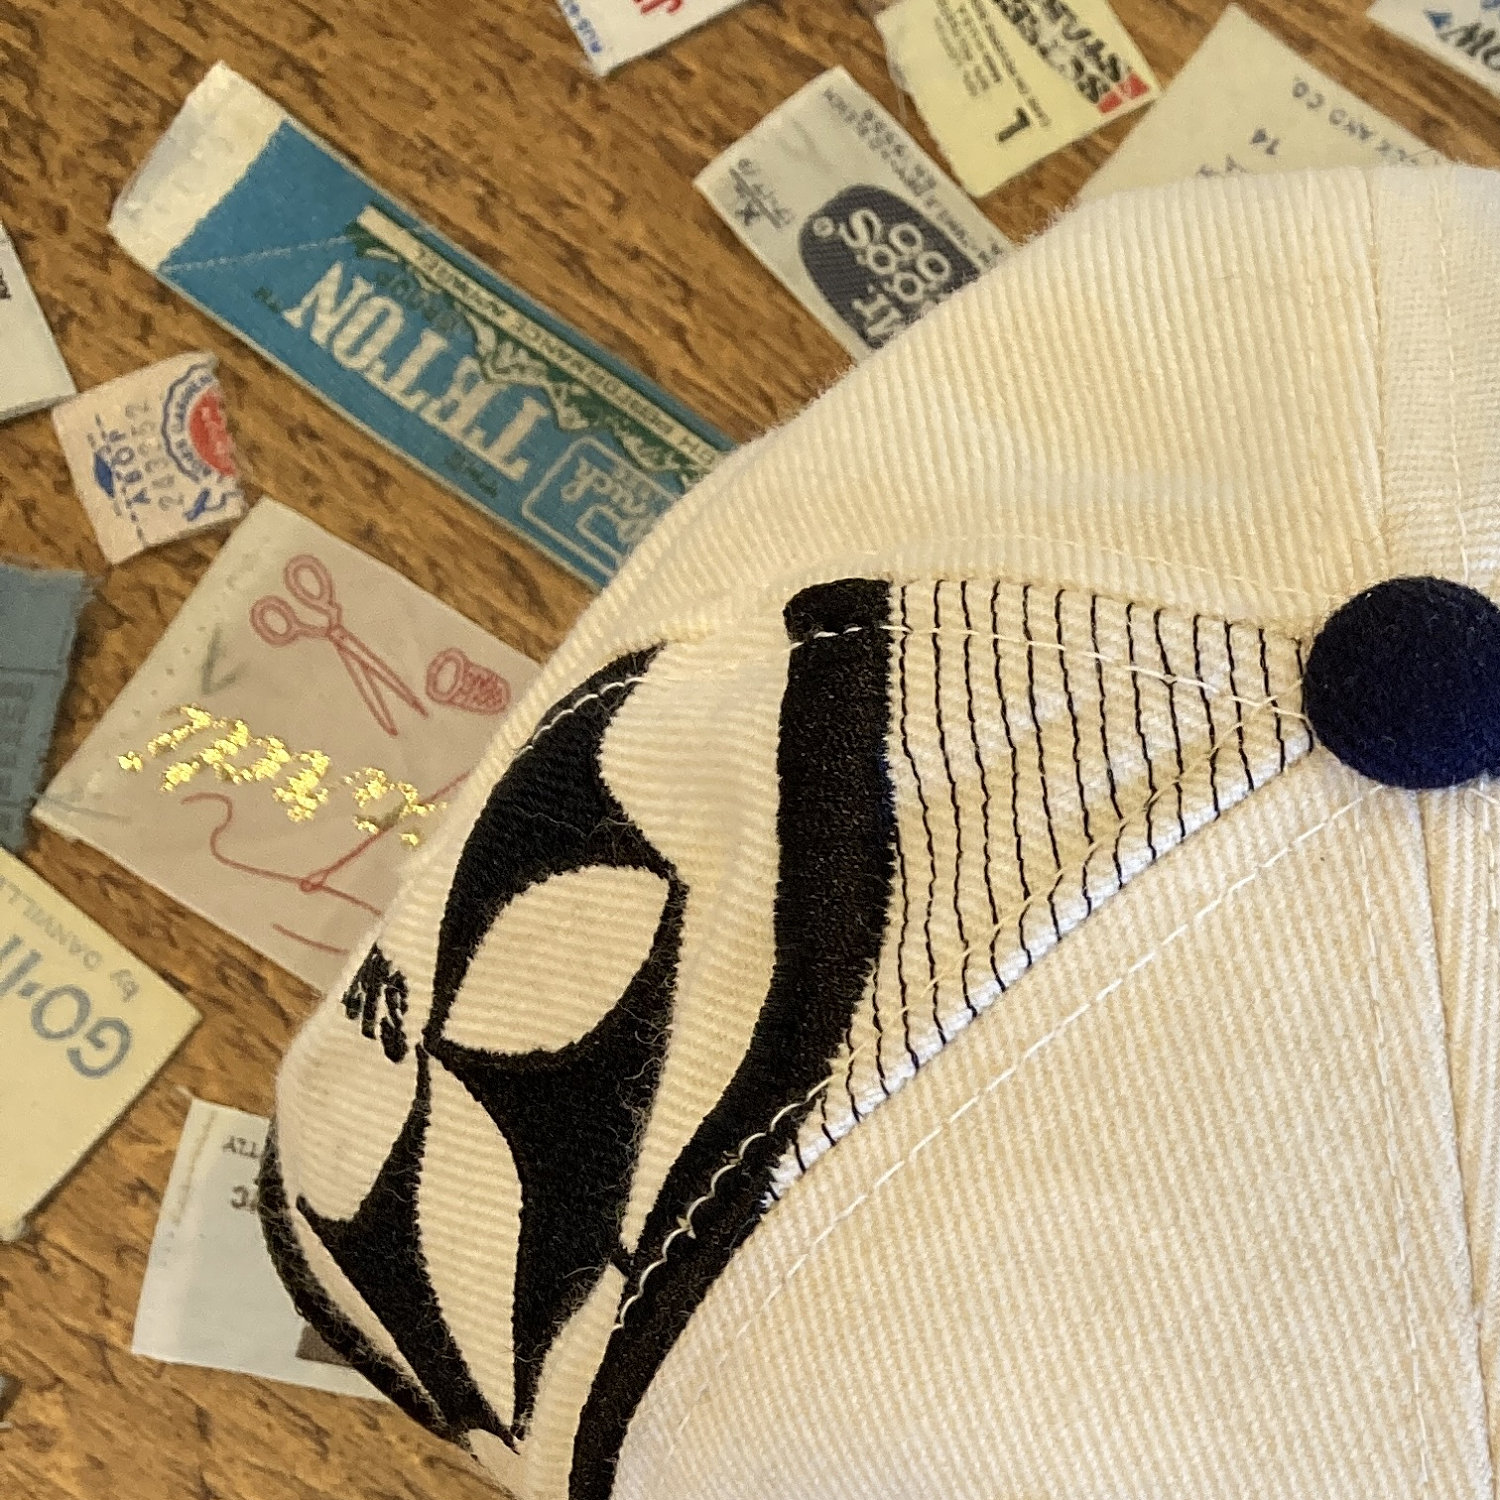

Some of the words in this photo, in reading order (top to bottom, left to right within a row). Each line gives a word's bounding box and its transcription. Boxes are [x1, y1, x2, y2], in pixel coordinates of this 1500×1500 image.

[988, 106, 1032, 144] L
[1246, 123, 1284, 159] 14
[829, 186, 966, 324] ggs
[280, 258, 550, 483] TETON
[100, 961, 145, 1005] by
